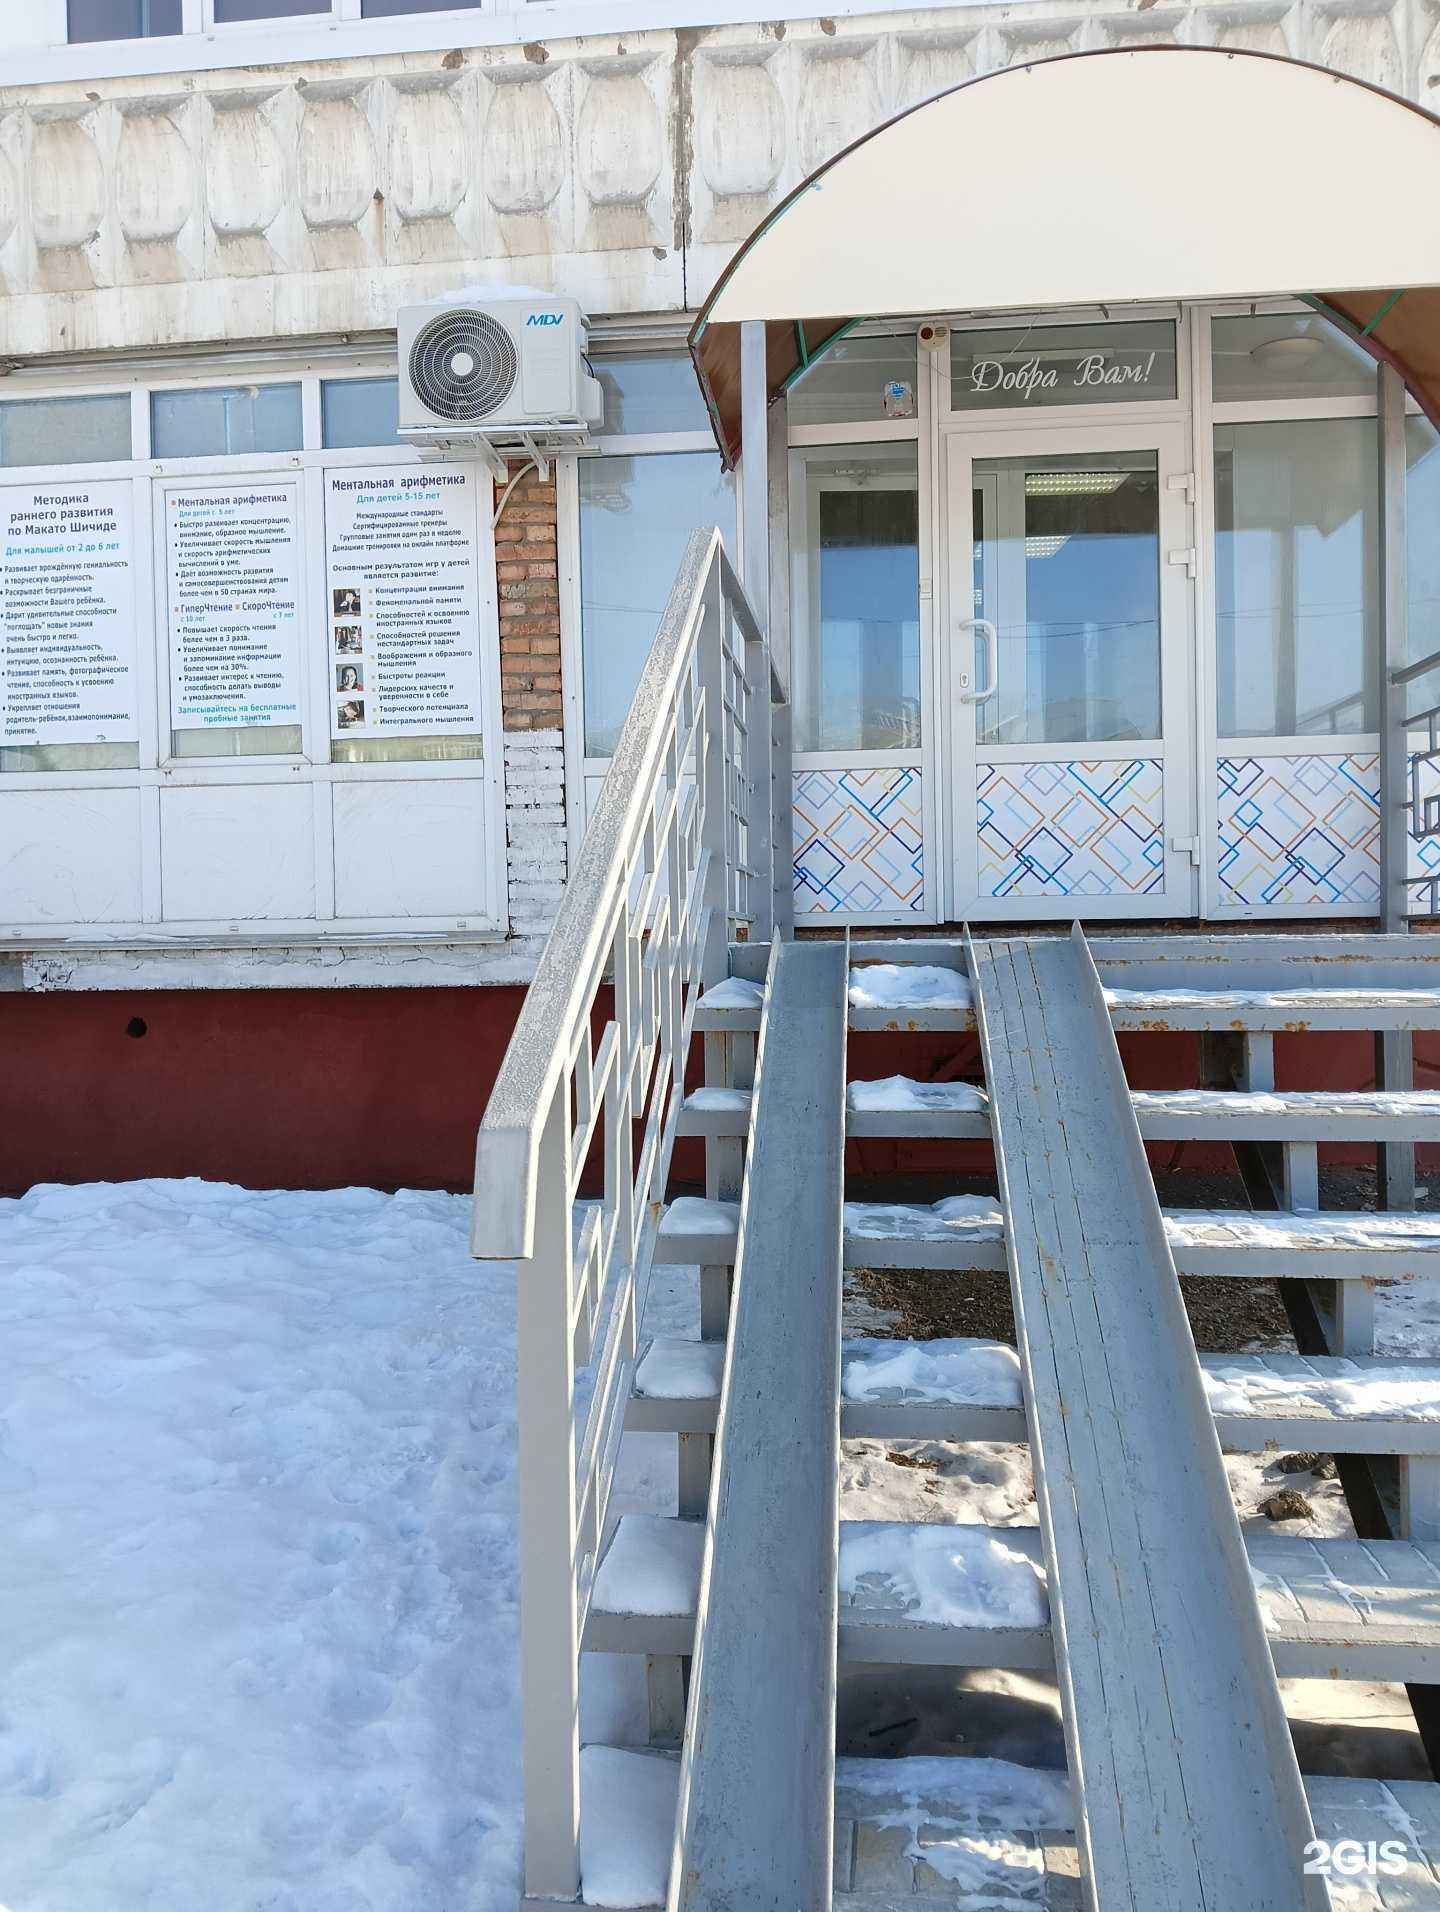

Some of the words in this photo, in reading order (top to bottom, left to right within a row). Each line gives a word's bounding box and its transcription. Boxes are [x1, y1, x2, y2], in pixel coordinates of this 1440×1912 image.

[527, 314, 563, 326] MDV
[970, 356, 1058, 399] Добра
[1074, 352, 1156, 386] Вам!
[333, 480, 394, 490] Ментальная
[401, 475, 465, 490] арифметика
[33, 495, 88, 505] Методика
[178, 497, 230, 507] Ментальная
[233, 494, 287, 505] арифметика
[11, 511, 56, 523] раннего
[61, 508, 113, 520] развития
[25, 525, 66, 534] Макато
[70, 522, 116, 532] Шичиде
[181, 604, 232, 614] ГиперЧтение
[243, 601, 294, 610] СкороЧтение
